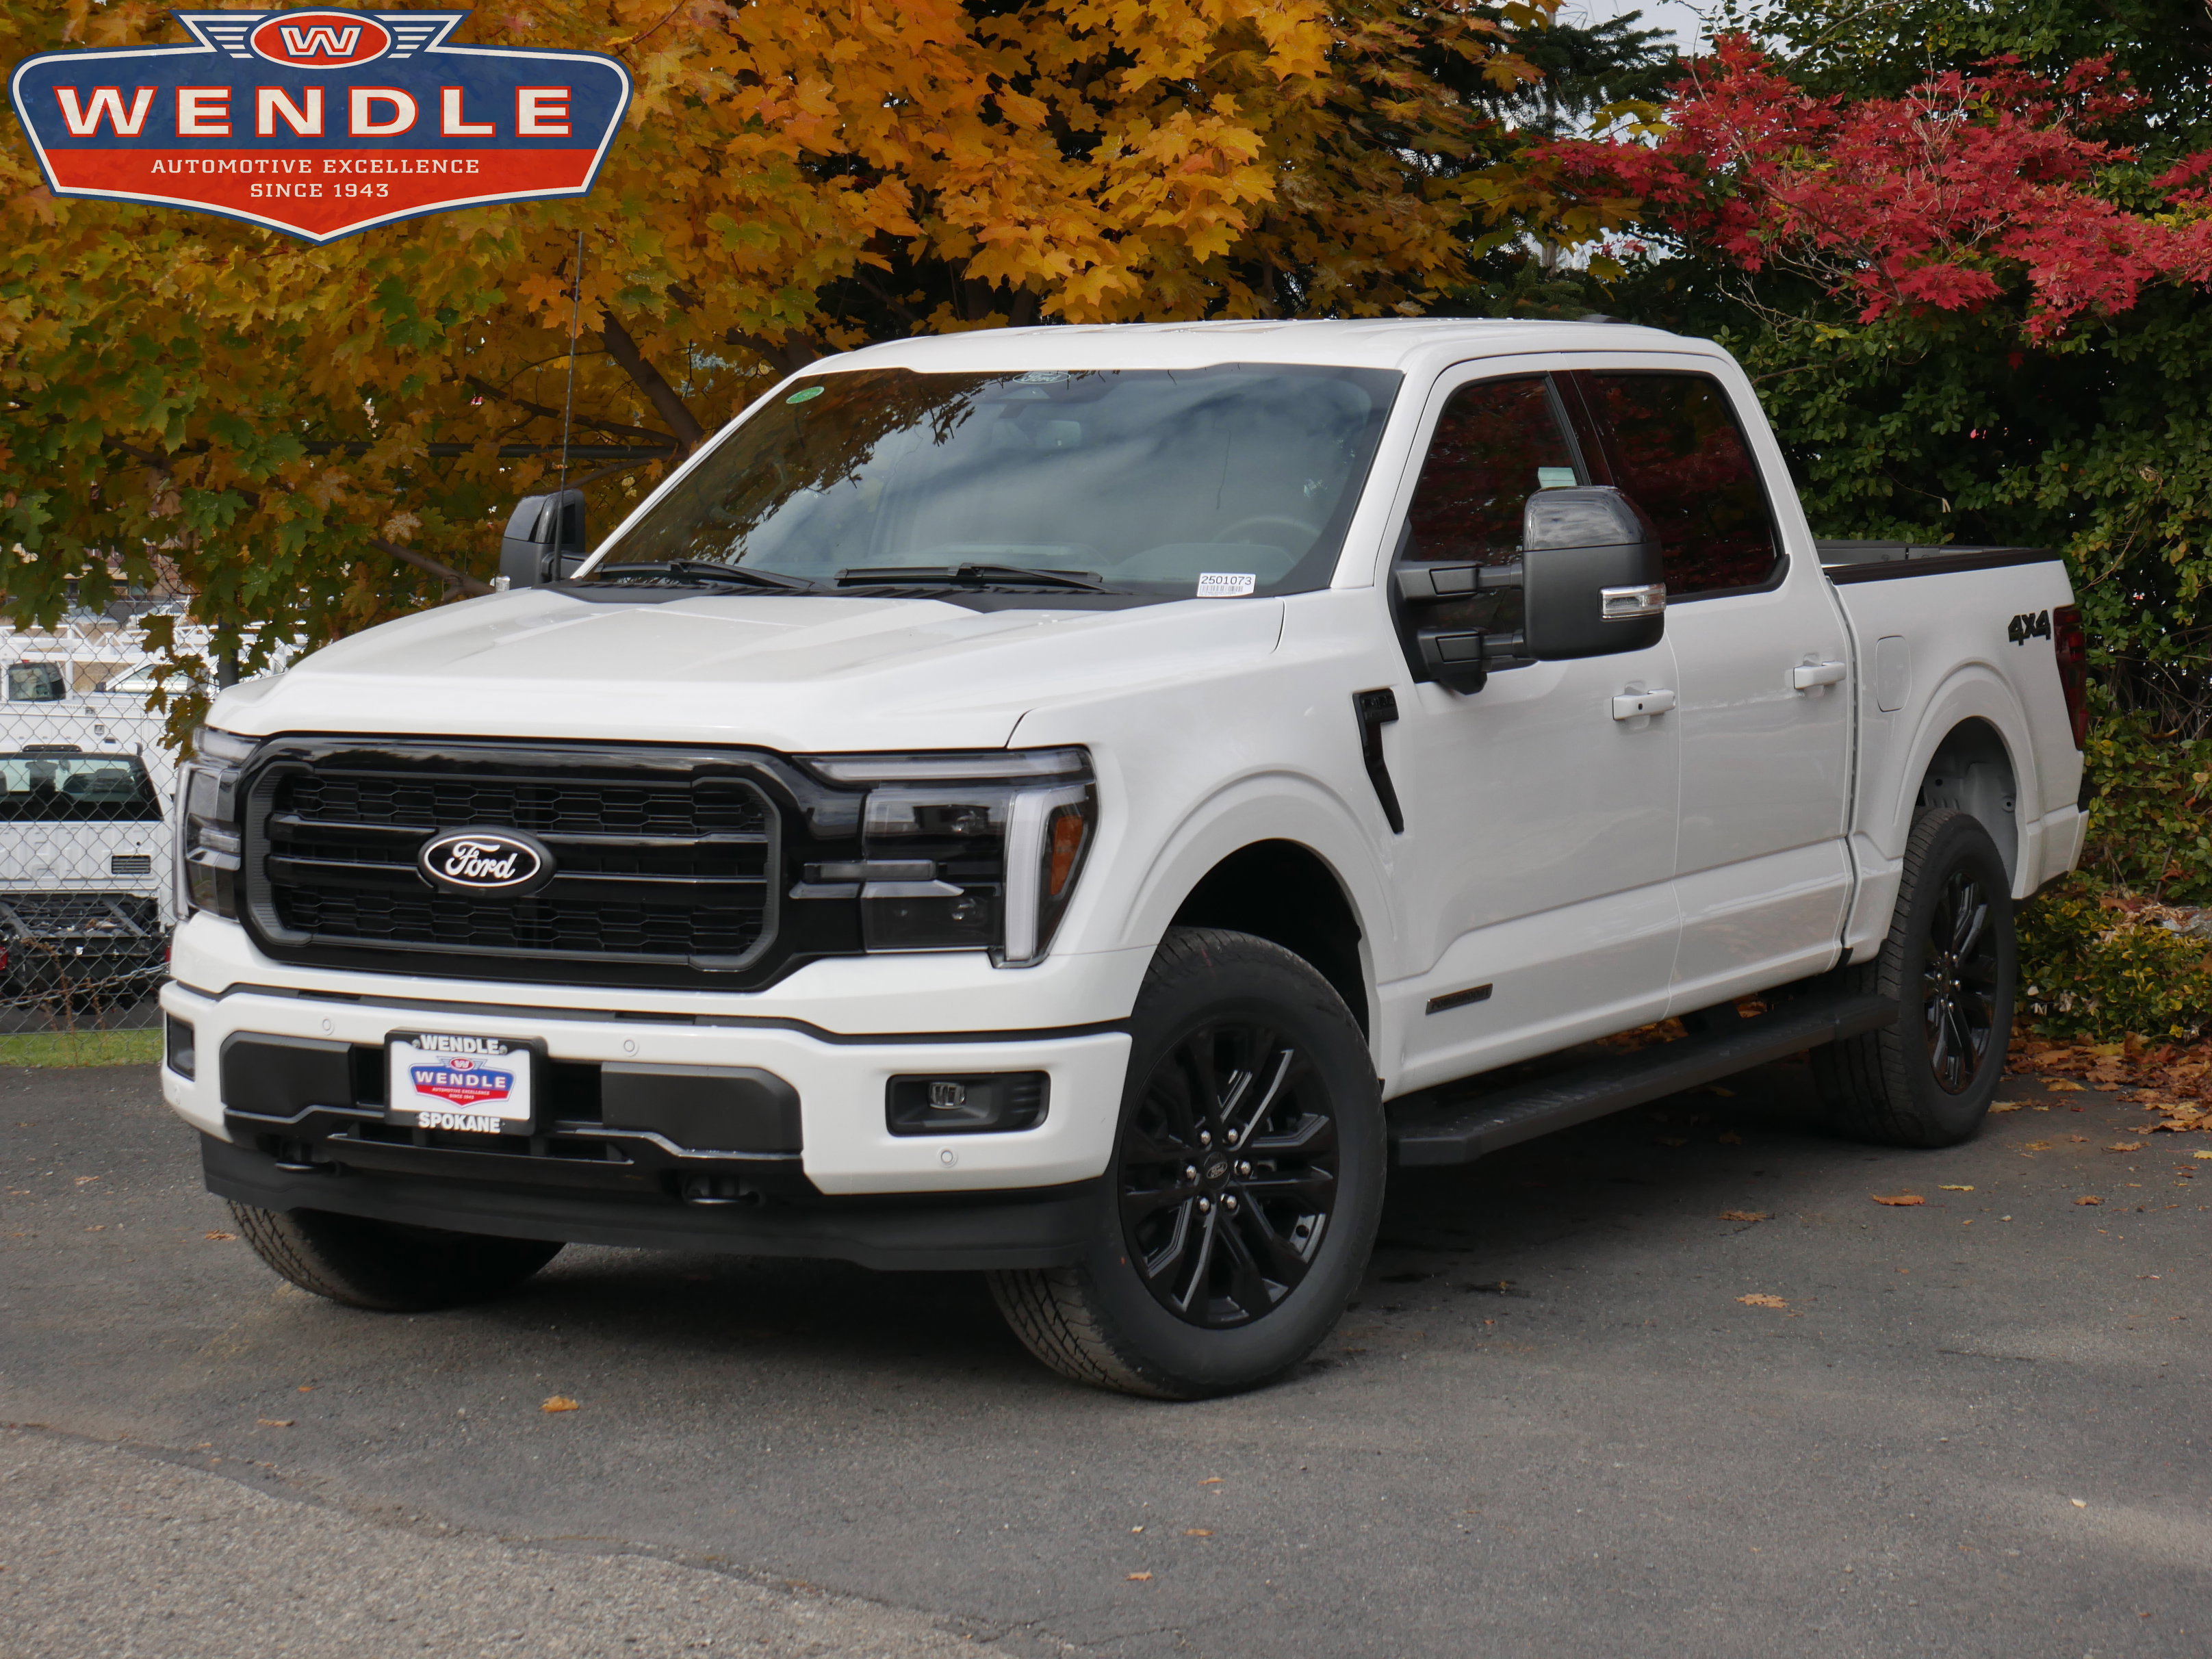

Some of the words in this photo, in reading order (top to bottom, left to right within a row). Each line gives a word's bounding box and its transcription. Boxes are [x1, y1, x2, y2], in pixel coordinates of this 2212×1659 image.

[1021, 372, 1062, 382] Ford
[1201, 576, 1252, 585] 2501073
[446, 841, 518, 879] Ford
[420, 1035, 500, 1055] WENDLE
[415, 1071, 506, 1089] WENDLE
[418, 1111, 501, 1133] SPOKANE
